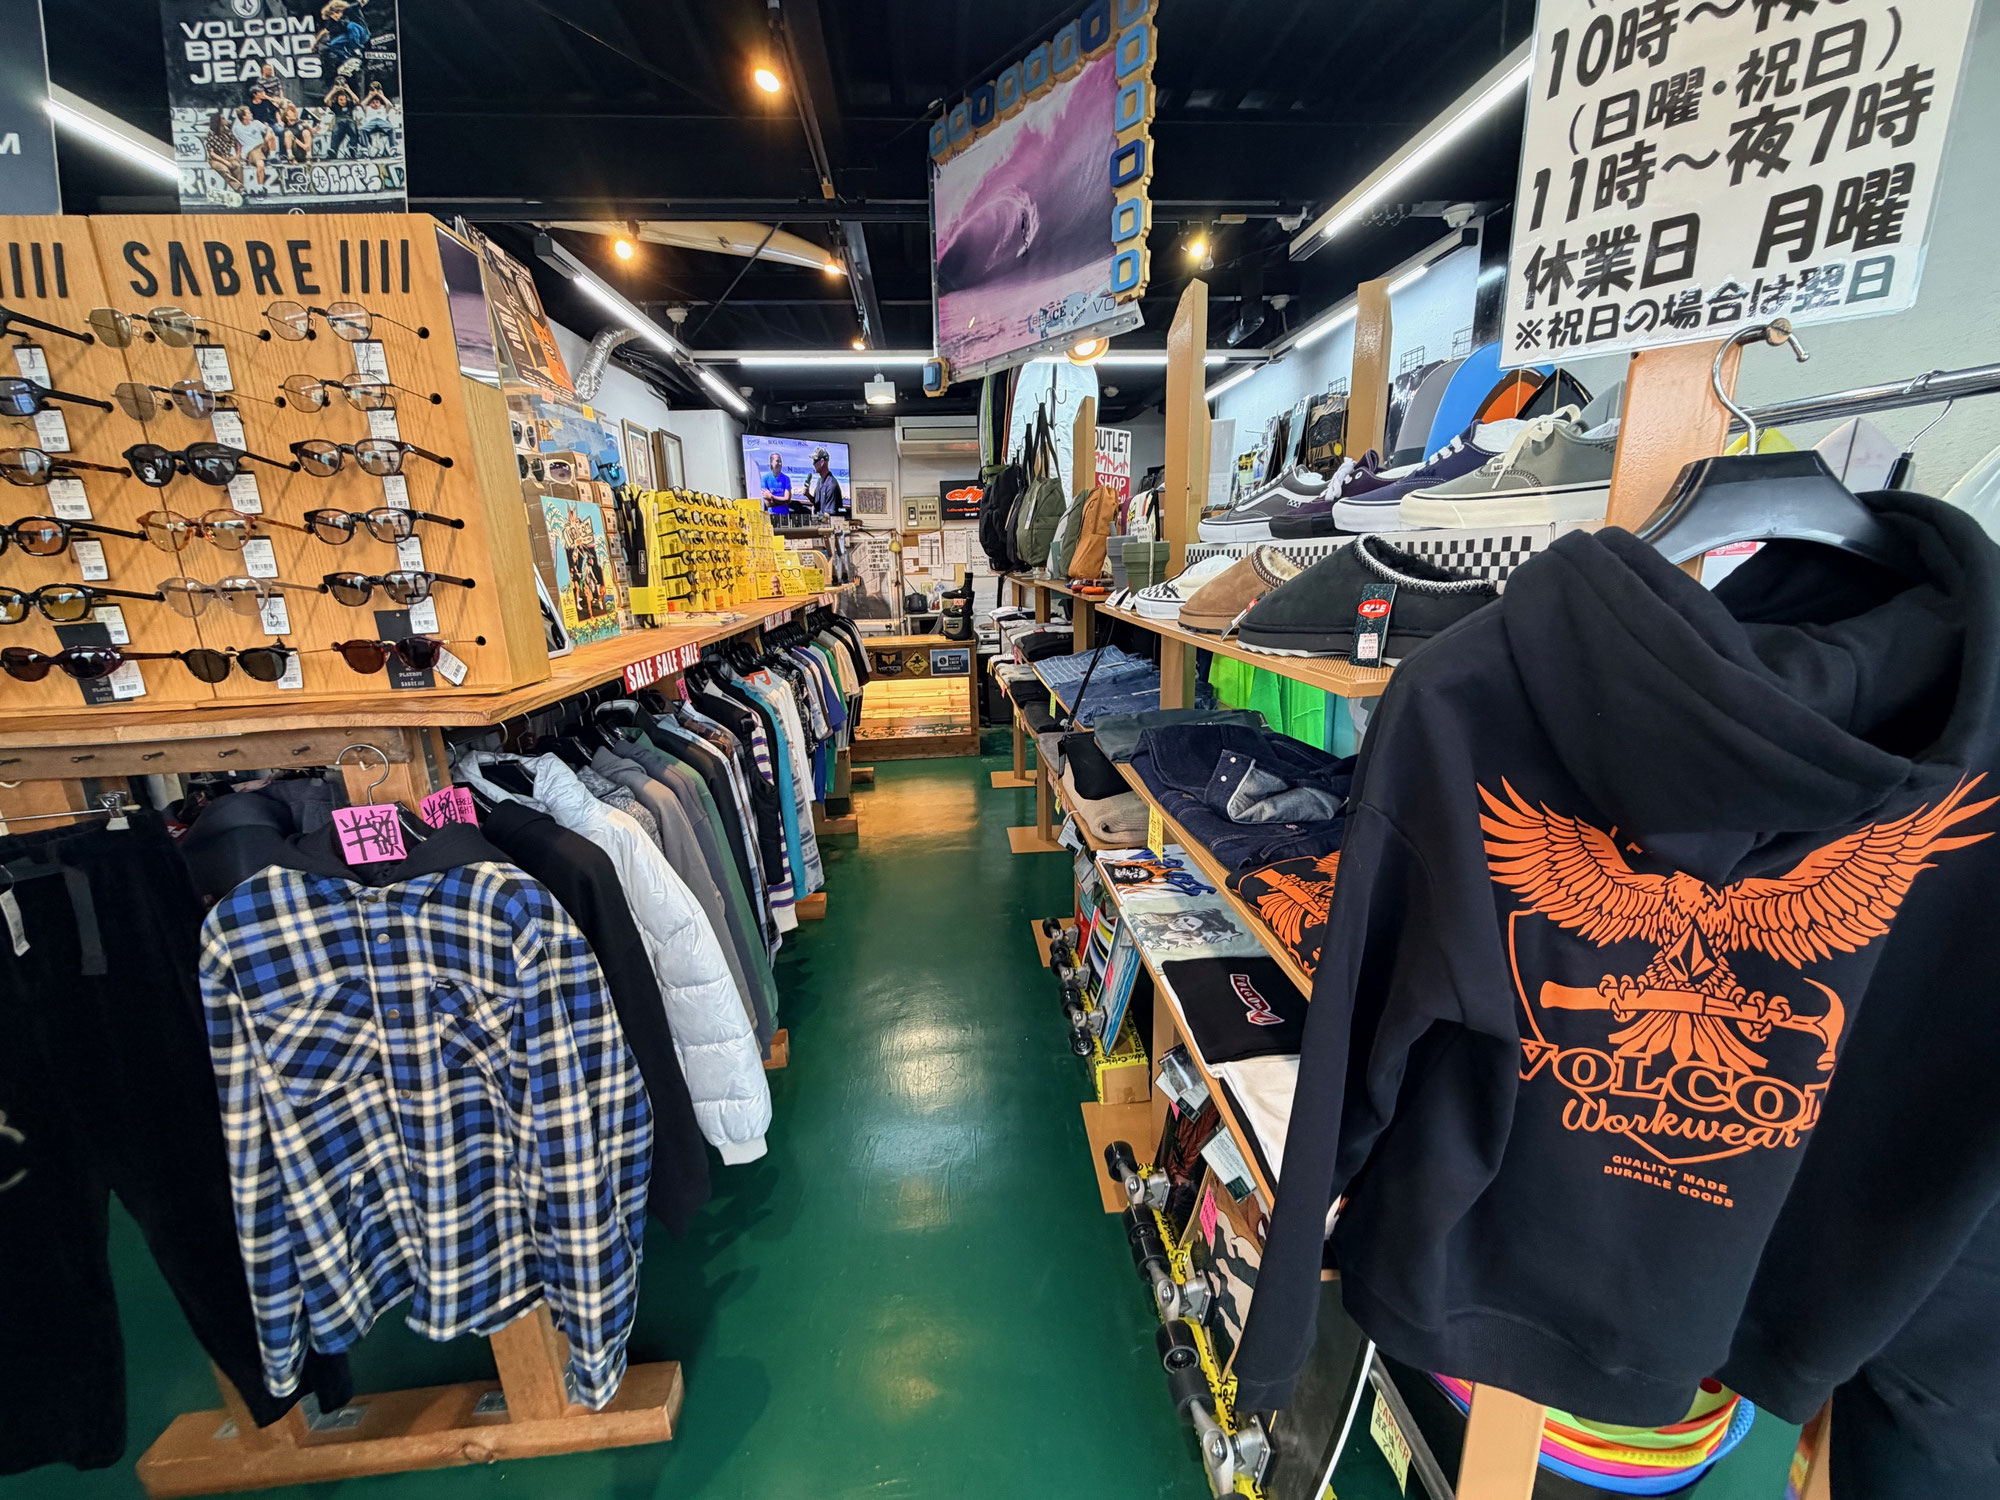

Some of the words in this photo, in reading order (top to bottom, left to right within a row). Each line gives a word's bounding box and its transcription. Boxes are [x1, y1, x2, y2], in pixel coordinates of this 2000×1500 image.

[180, 15, 316, 39] VOLCOM
[184, 34, 317, 61] BRAND
[190, 57, 323, 84] JEANS
[1524, 212, 1700, 311] 休業日
[1752, 162, 1916, 269] 月曜
[123, 239, 322, 297] SABRE
[1098, 474, 1126, 491] SHOP
[1362, 604, 1387, 613] SALE
[626, 658, 654, 691] SALE
[656, 649, 678, 678] SALE
[681, 642, 699, 669] SALE
[423, 791, 459, 829] 半額
[339, 810, 406, 861] 半額
[1562, 1097, 1801, 1149] Workwear
[1603, 1165, 1672, 1190] DURABLE
[1677, 1184, 1734, 1209] GOODS
[1612, 1155, 1677, 1178] QUALITY
[1683, 1172, 1728, 1194] MADE
